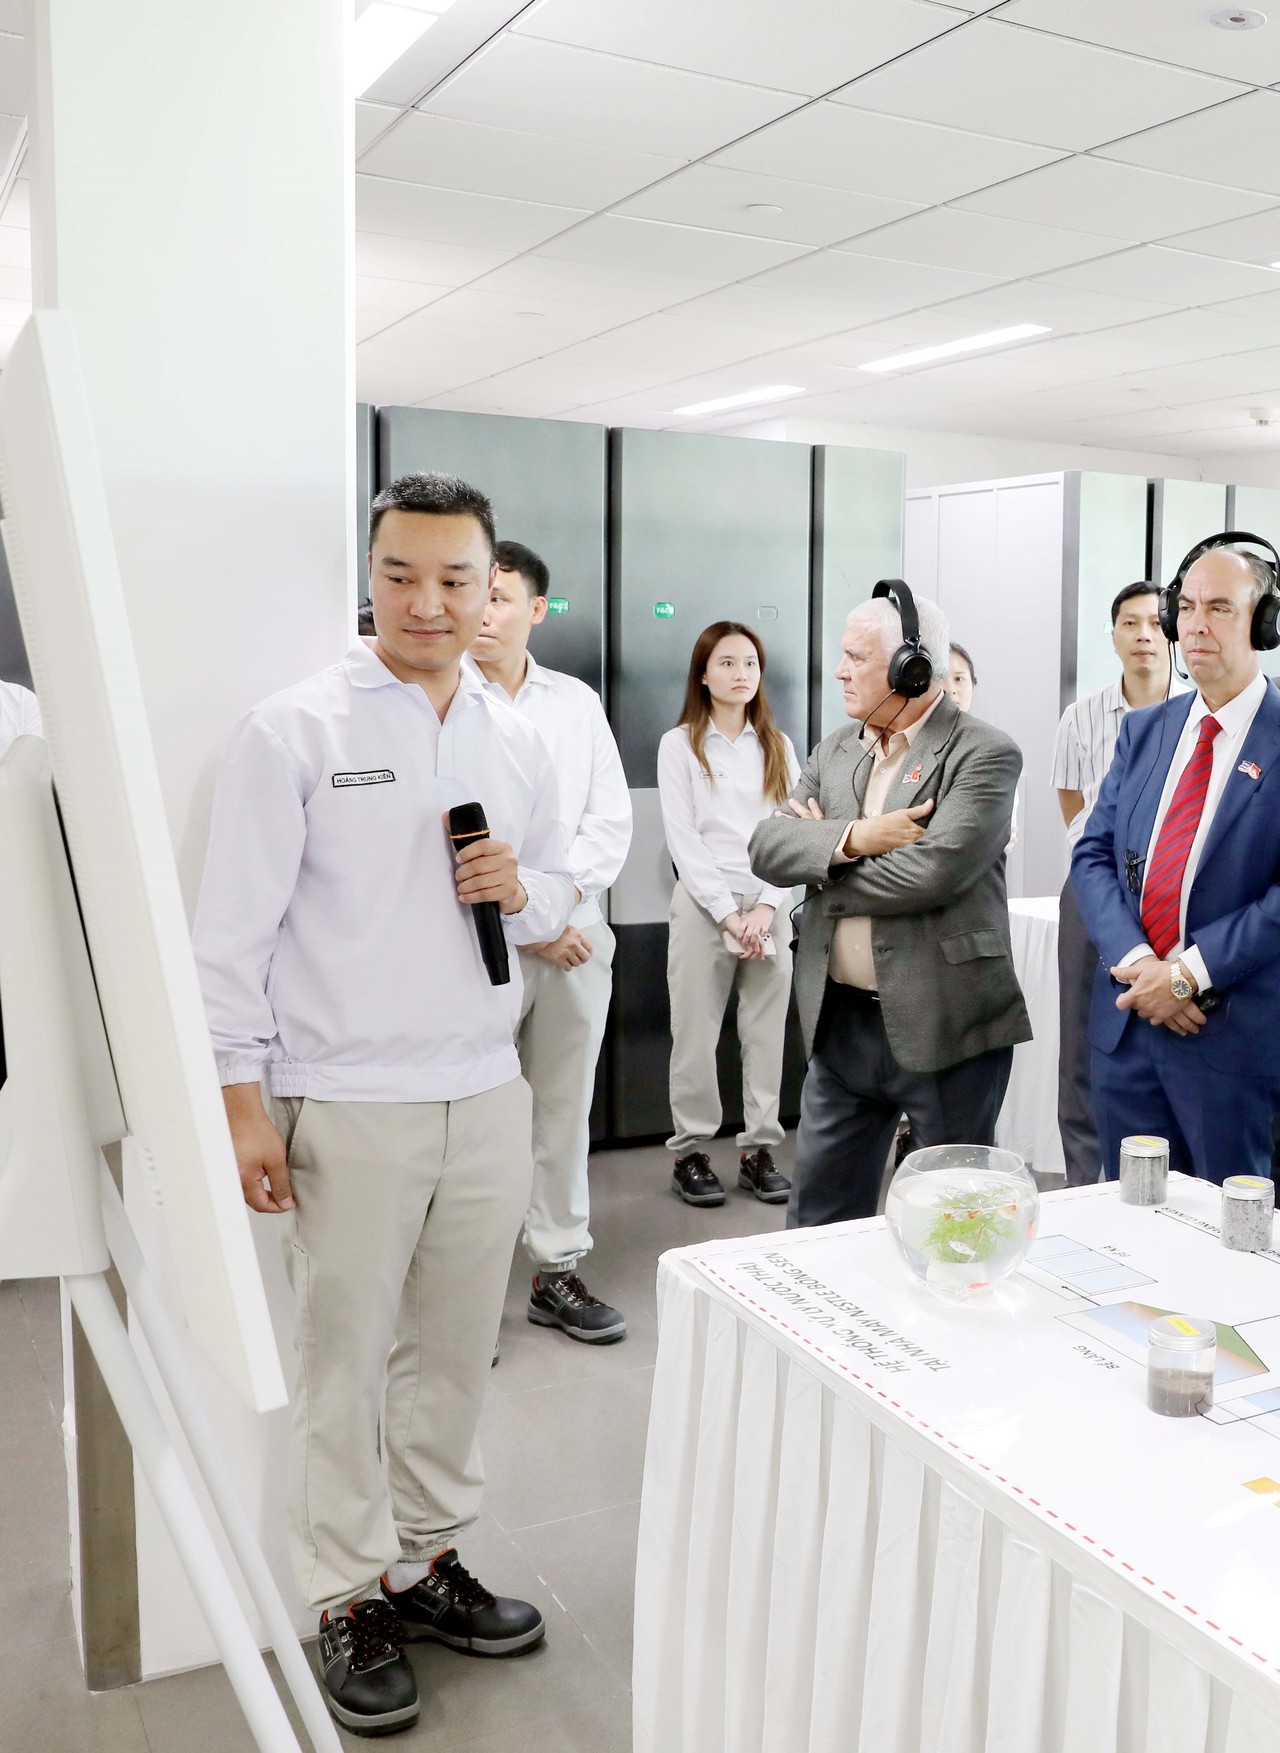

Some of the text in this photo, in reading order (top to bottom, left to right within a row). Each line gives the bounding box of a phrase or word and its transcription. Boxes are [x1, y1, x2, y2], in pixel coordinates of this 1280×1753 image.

[357, 775, 377, 783] TRUNG
[763, 1281, 806, 1305] NƯỚC
[761, 1252, 952, 1372] TẠI NHÀ MÁY NESTLE BÔNG SEN
[832, 1328, 888, 1361] THỐNG
